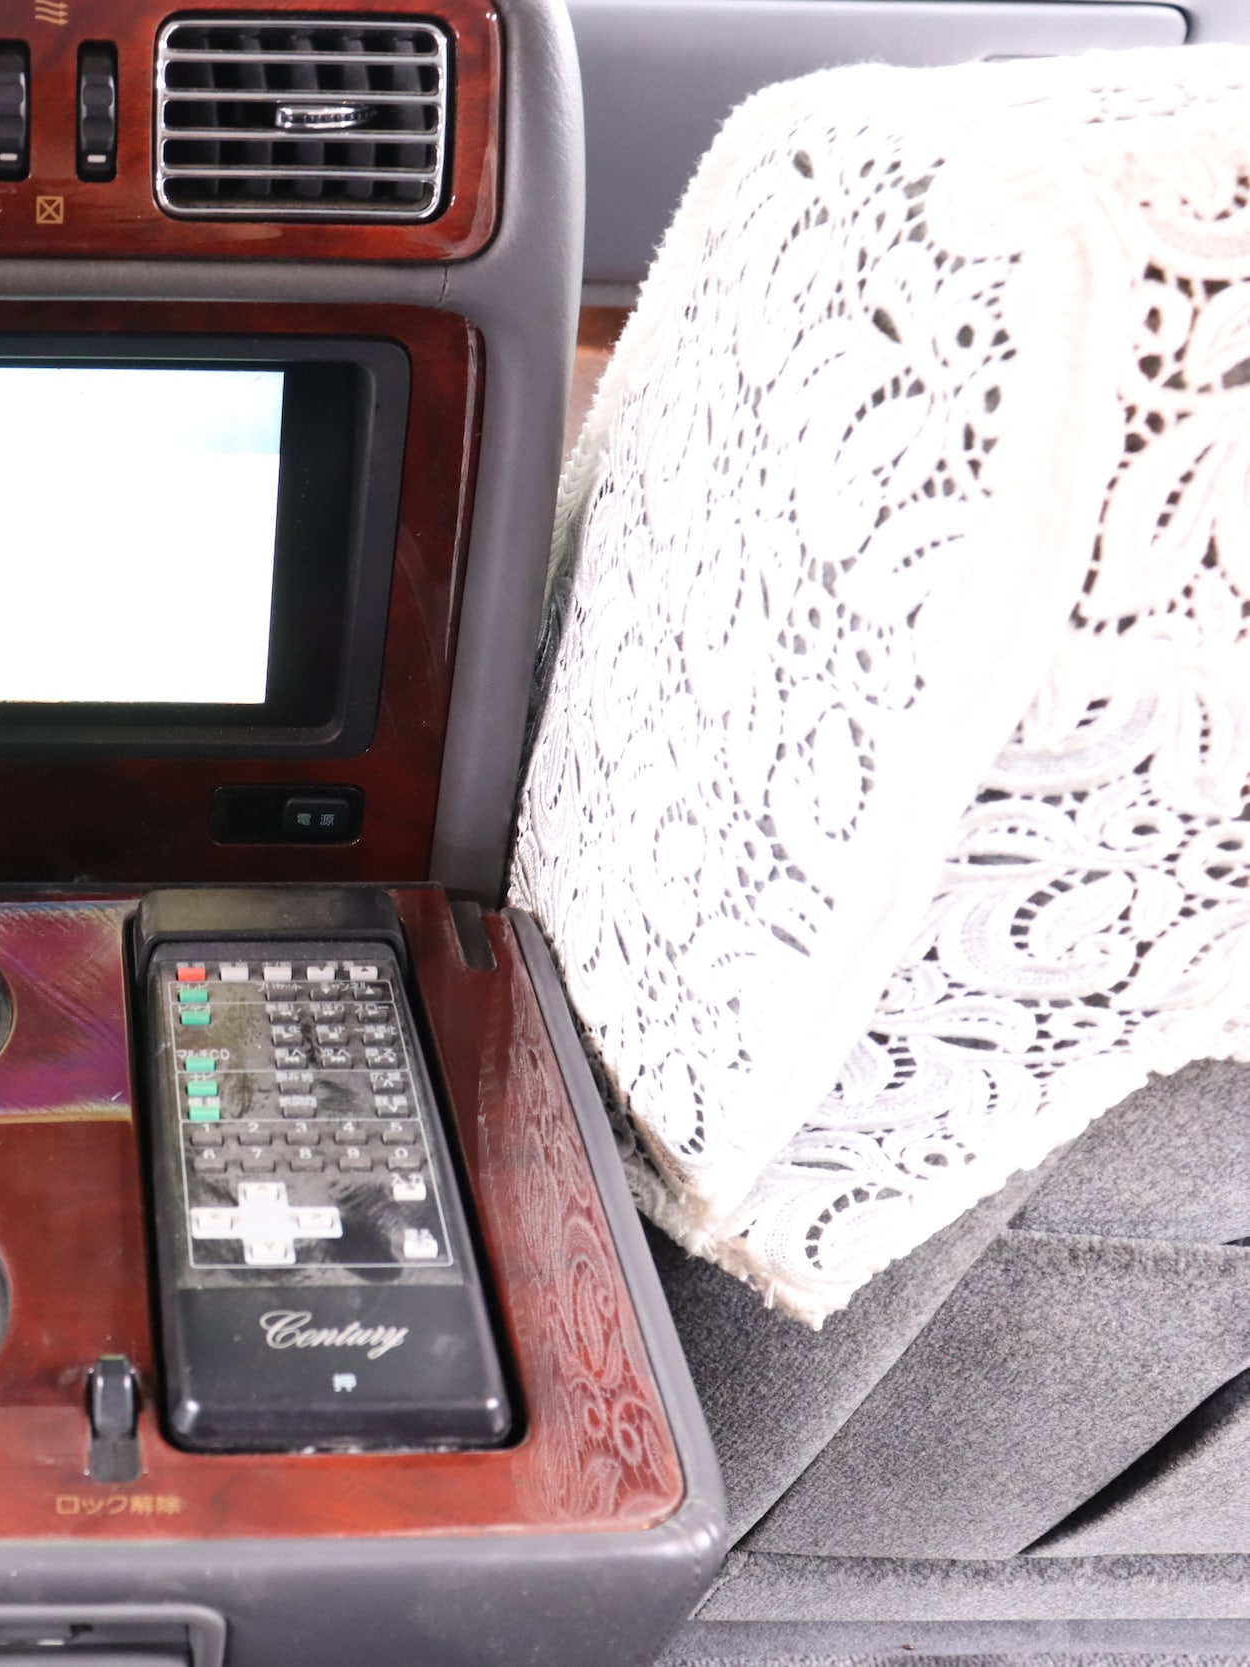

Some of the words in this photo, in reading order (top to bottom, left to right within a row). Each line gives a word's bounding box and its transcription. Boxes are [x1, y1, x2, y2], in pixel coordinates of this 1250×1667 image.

[297, 813, 335, 826] 電源
[248, 1122, 260, 1133] 2
[296, 1122, 308, 1133] 3
[343, 1122, 355, 1133] 4
[390, 1122, 403, 1133] 5
[251, 1147, 263, 1159] 7
[299, 1147, 312, 1159] 8
[347, 1147, 360, 1159] 9
[394, 1147, 408, 1159] 0
[259, 1310, 410, 1360] Century
[56, 1494, 182, 1515] ロック解除
